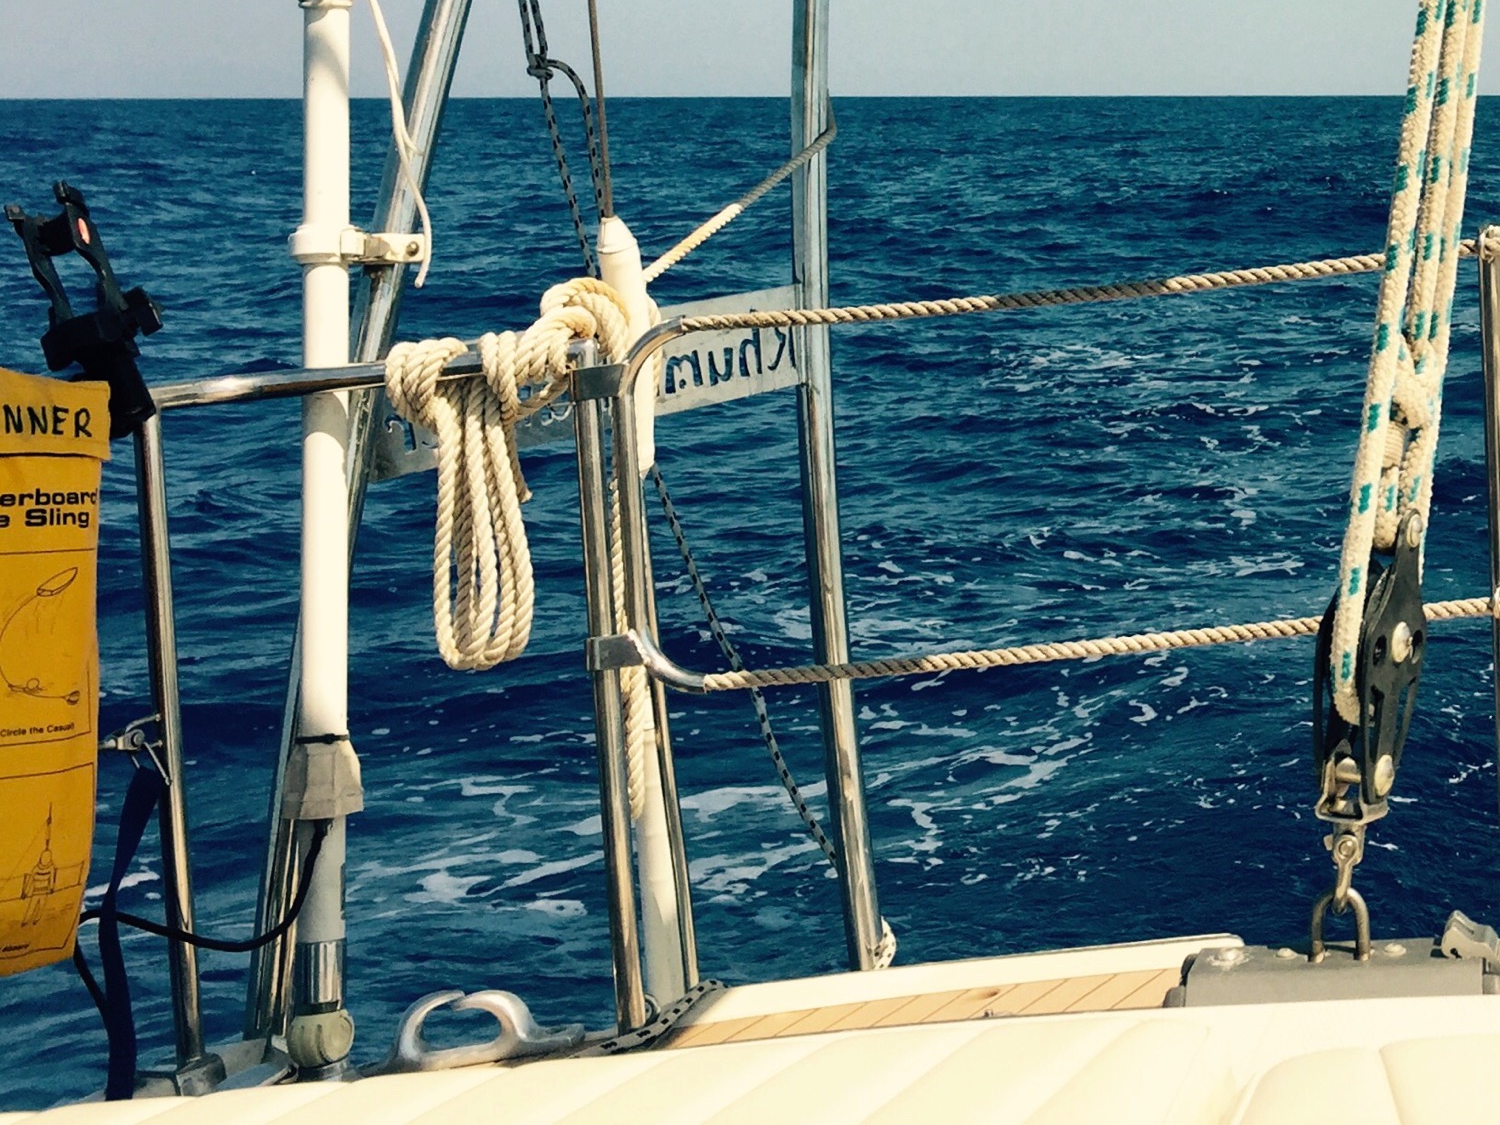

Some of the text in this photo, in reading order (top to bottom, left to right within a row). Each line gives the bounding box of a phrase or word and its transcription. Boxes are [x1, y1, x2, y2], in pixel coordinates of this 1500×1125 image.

[25, 508, 90, 529] Sling
[0, 728, 27, 737] Circle
[29, 726, 44, 735] the
